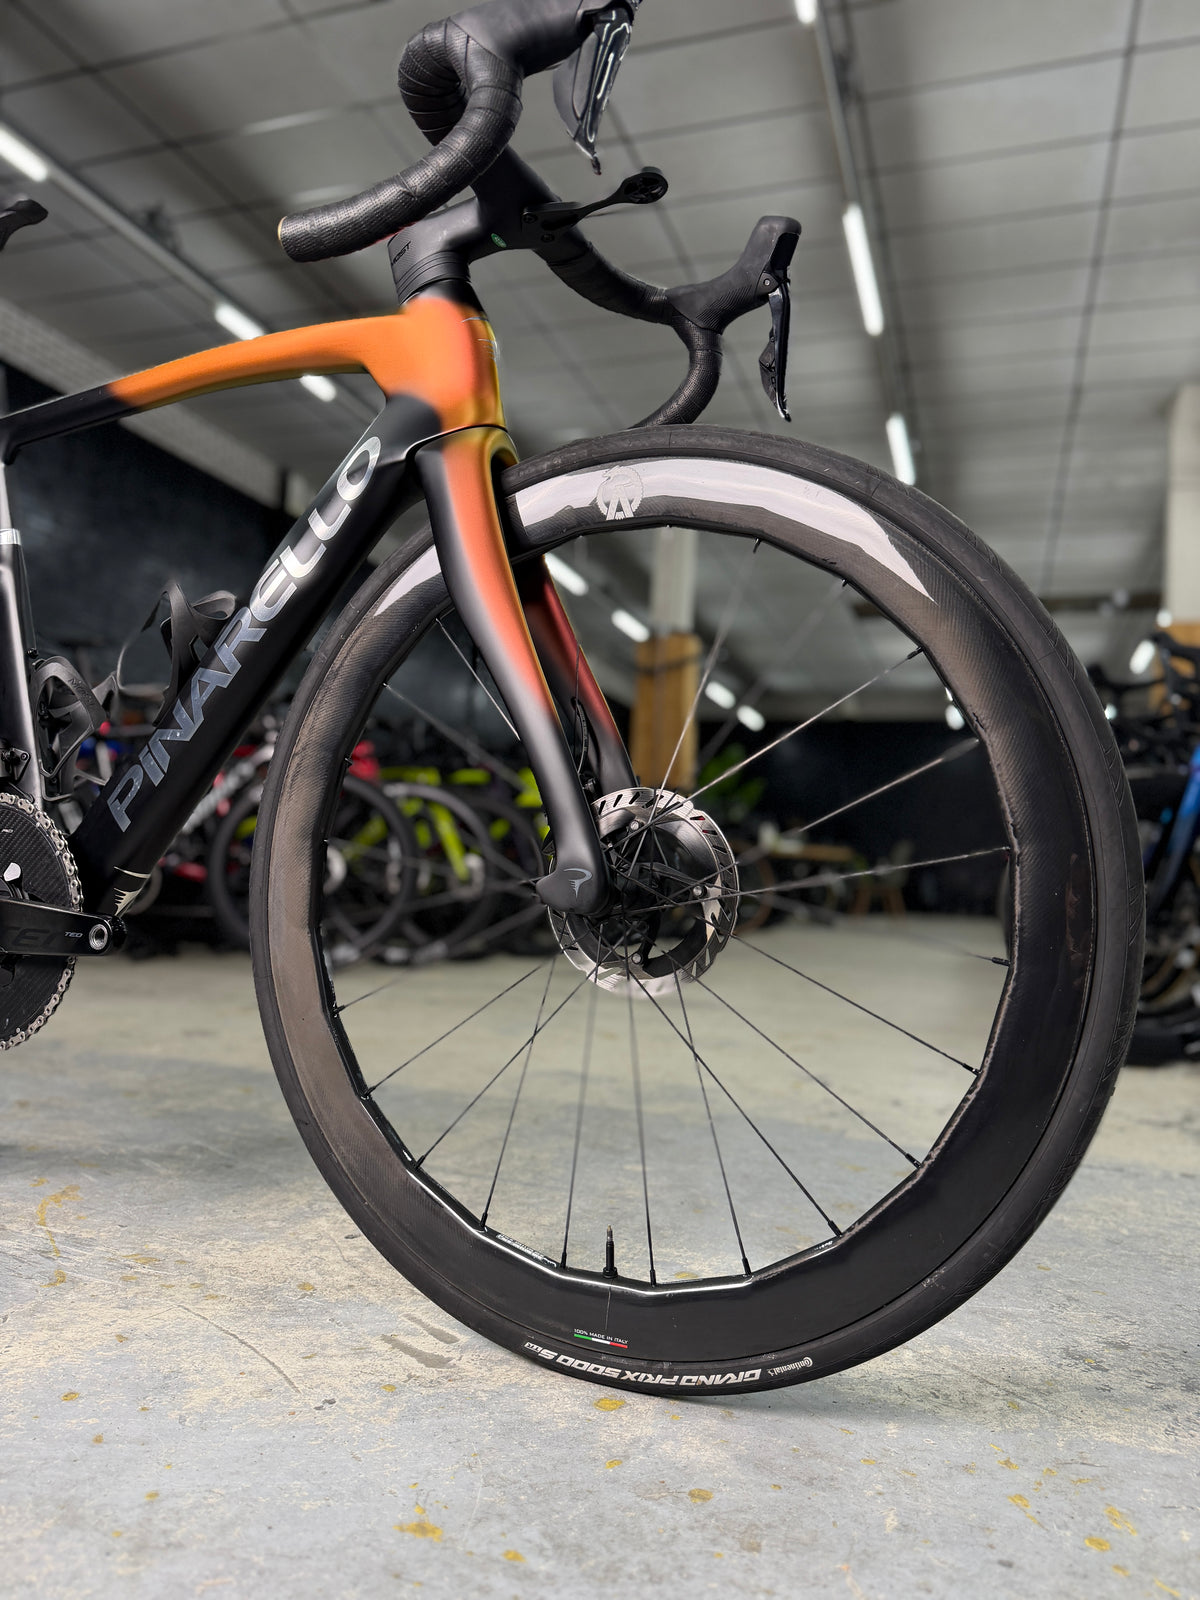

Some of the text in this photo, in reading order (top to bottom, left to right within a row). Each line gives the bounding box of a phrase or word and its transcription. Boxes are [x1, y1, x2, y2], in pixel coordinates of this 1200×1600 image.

[107, 436, 381, 832] PINARELLO
[590, 1332, 606, 1340] MADE
[614, 1337, 628, 1345] ITALY
[556, 1354, 622, 1379] 5000
[620, 1370, 679, 1386] PRIX
[680, 1368, 762, 1386] GRAND
